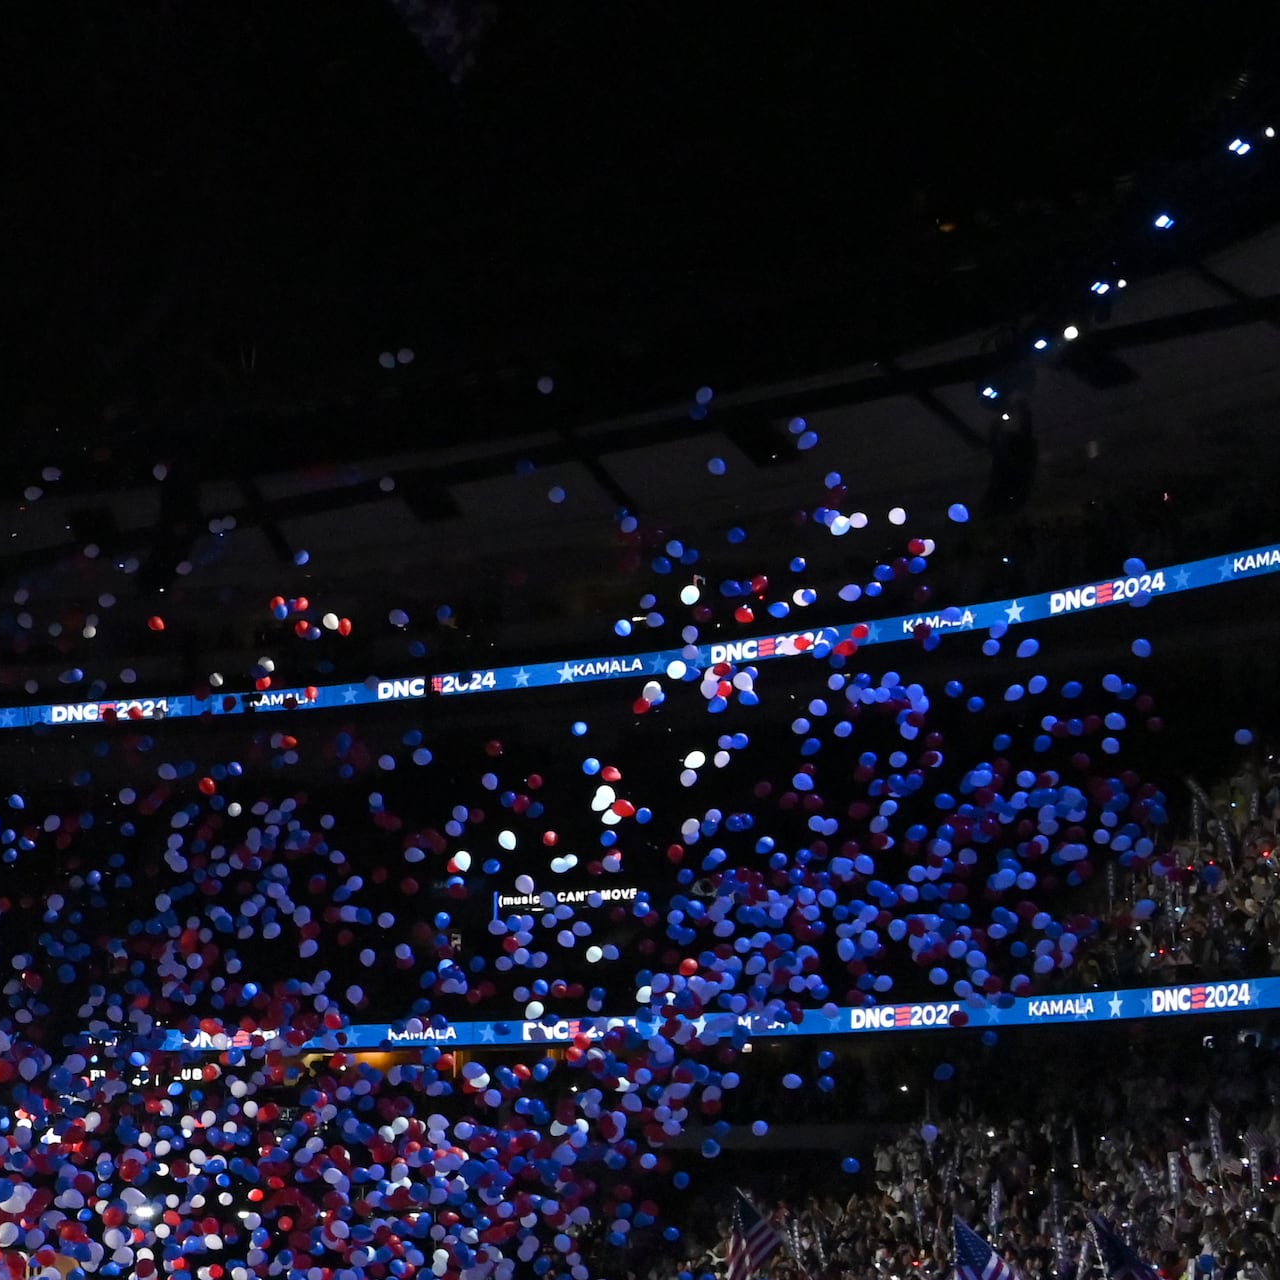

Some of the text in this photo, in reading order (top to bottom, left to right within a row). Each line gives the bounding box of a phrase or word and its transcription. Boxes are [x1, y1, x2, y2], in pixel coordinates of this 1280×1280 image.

[573, 659, 643, 677] KAMALA
[1205, 983, 1251, 1009] 2024
[1028, 999, 1093, 1018] KAMALA
